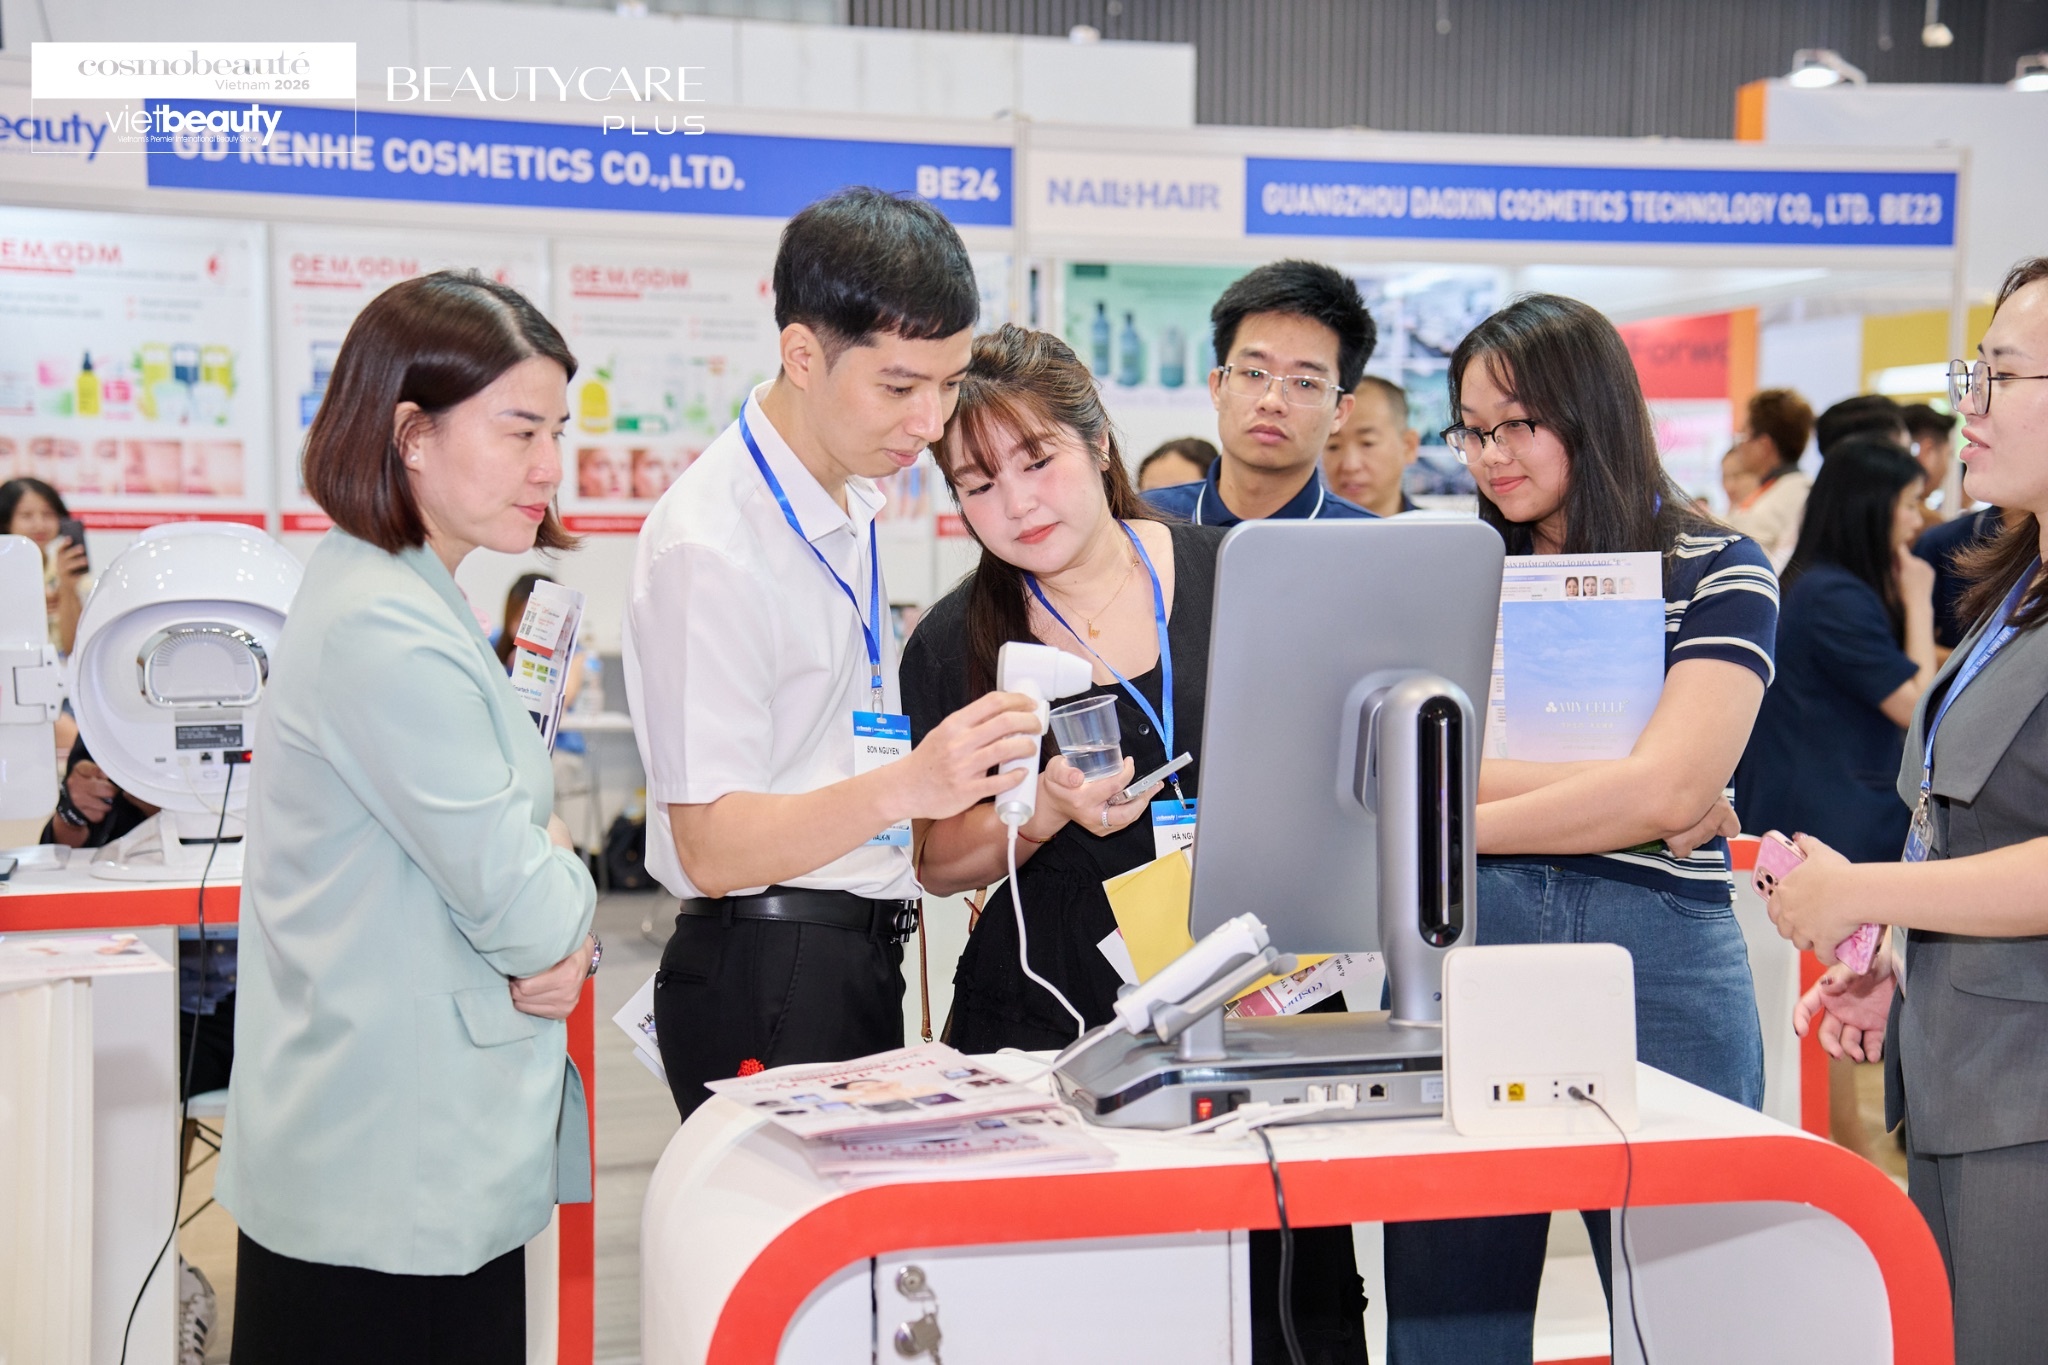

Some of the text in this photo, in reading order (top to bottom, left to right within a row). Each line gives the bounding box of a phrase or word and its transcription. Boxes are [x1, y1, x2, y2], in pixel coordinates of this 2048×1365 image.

[239, 130, 375, 171] RENHE
[382, 138, 594, 184] COSMETICS
[916, 164, 1000, 202] BE24
[1262, 182, 1408, 218] GUANGZHOU
[1499, 188, 1628, 222] COSMETICS
[1629, 190, 1777, 225] TECHNOLOGY
[1879, 192, 1943, 226] BE23
[866, 745, 900, 755] SON NGUYEN
